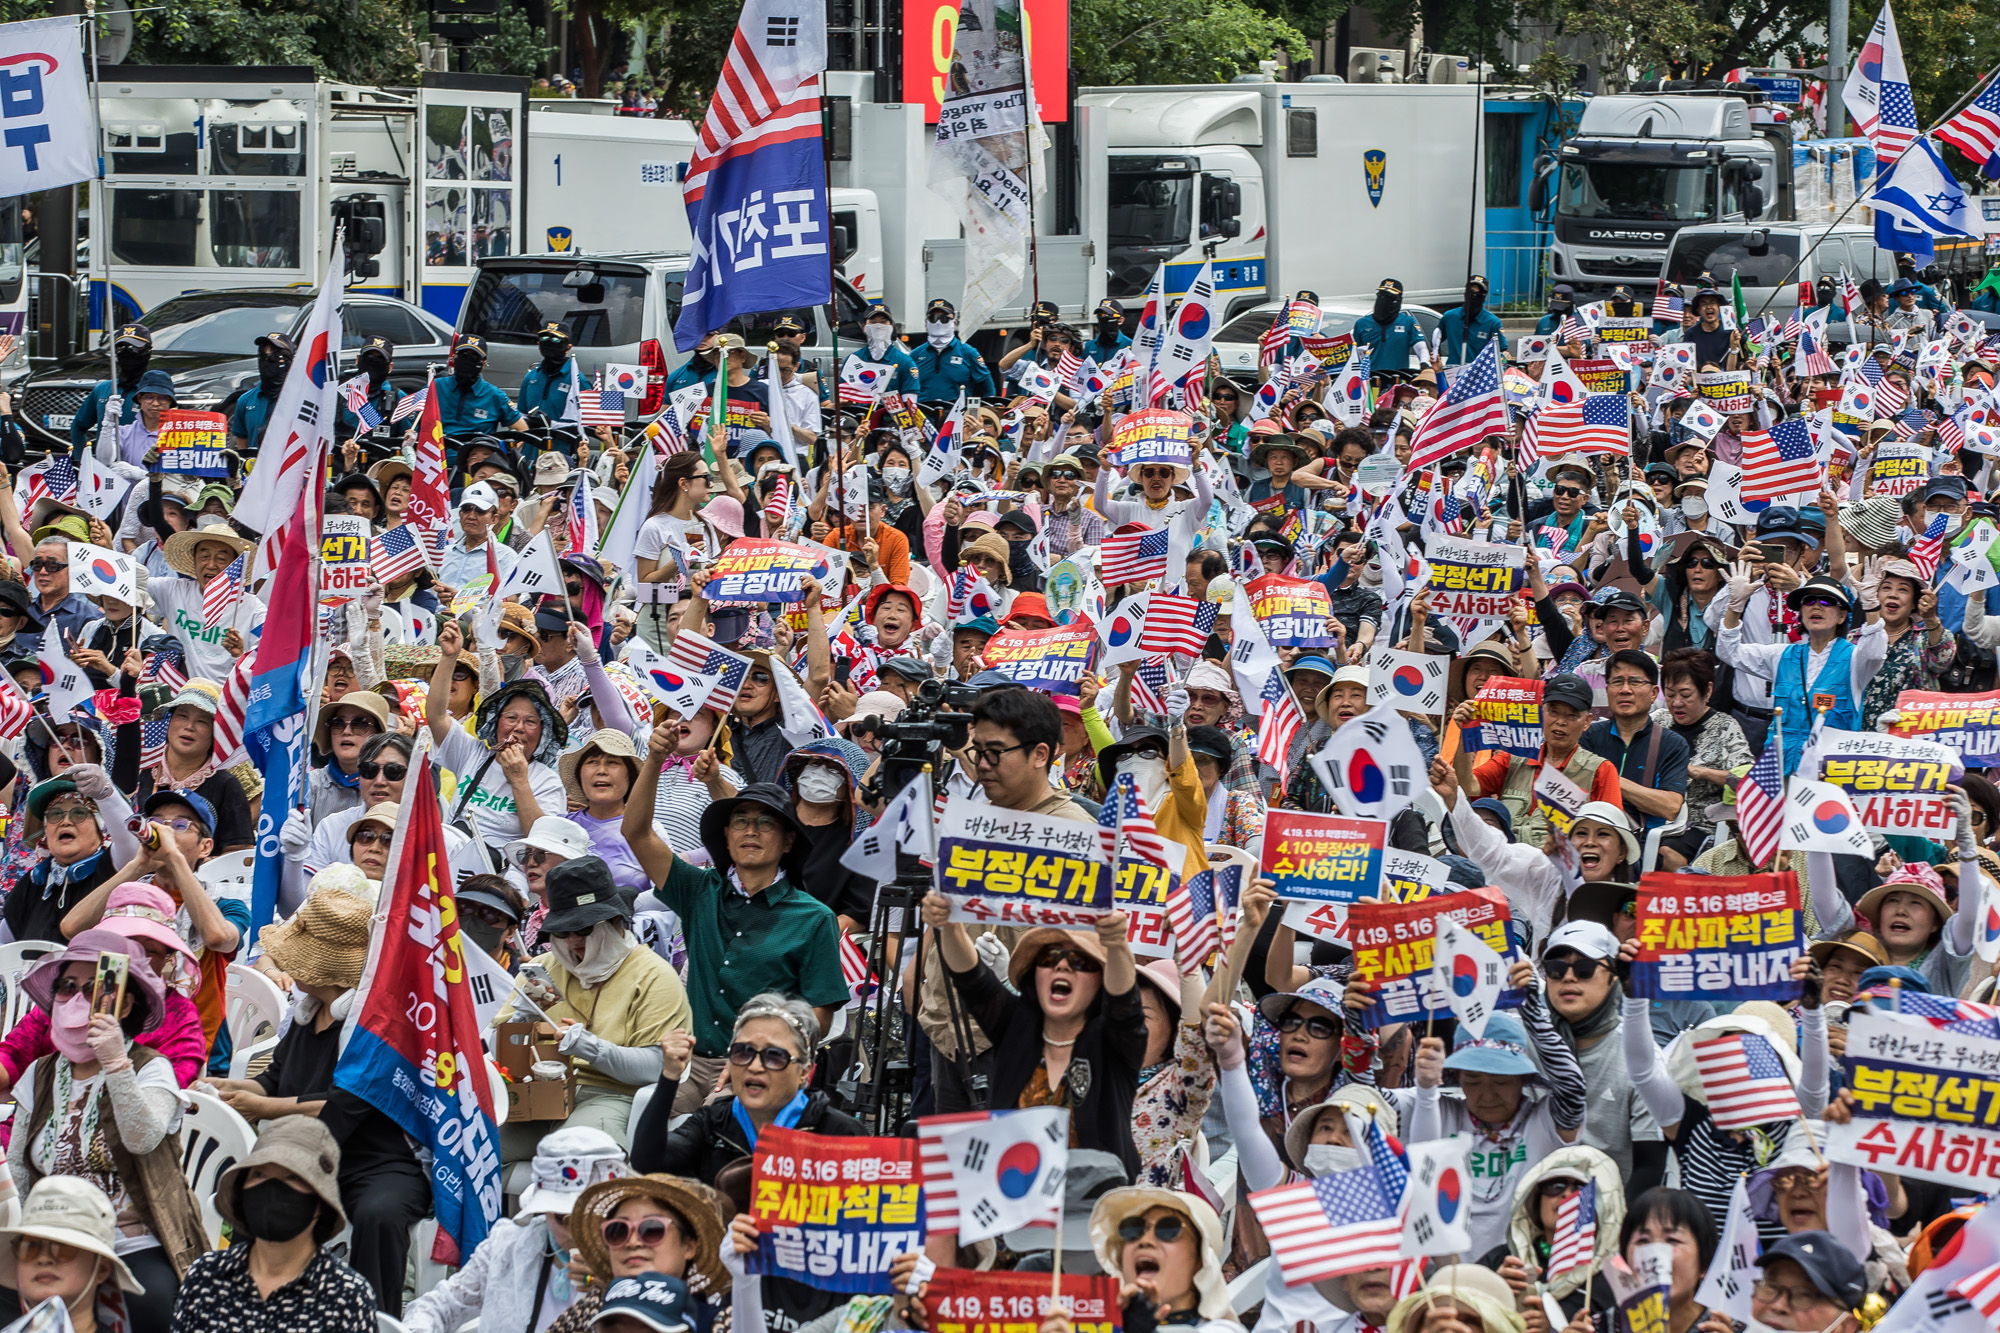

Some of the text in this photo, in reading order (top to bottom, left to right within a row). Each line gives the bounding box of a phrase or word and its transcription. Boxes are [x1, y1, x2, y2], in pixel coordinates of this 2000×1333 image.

[554, 153, 561, 186] 1
[1589, 229, 1666, 241] DAEWOO
[1601, 327, 1649, 342] 부정선거
[1701, 380, 1748, 399] 부정선거
[1120, 440, 1192, 463] 끝장내자
[321, 536, 366, 562] 선거
[1430, 562, 1512, 591] 부정선거
[1938, 700, 1967, 710] 5.16
[1825, 759, 1951, 791] 부정선거
[965, 816, 1035, 844] 대한민국
[1305, 829, 1325, 838] 5.16
[945, 845, 1101, 903] 부정선거
[1272, 857, 1369, 882] 수사하라!
[1647, 889, 1787, 916] 4.19, 5.16 혁명으로
[1356, 926, 1392, 946] 4.19,
[1394, 917, 1433, 941] 5.16
[1639, 908, 1796, 951] 주사파척결
[761, 1154, 913, 1182] 4.19, 5.16 혁명으로
[755, 1179, 919, 1226] 주사파척결
[772, 1225, 926, 1277] 끝장내자
[937, 1296, 985, 1320] 4.19,
[989, 1296, 1034, 1319] 5.16
